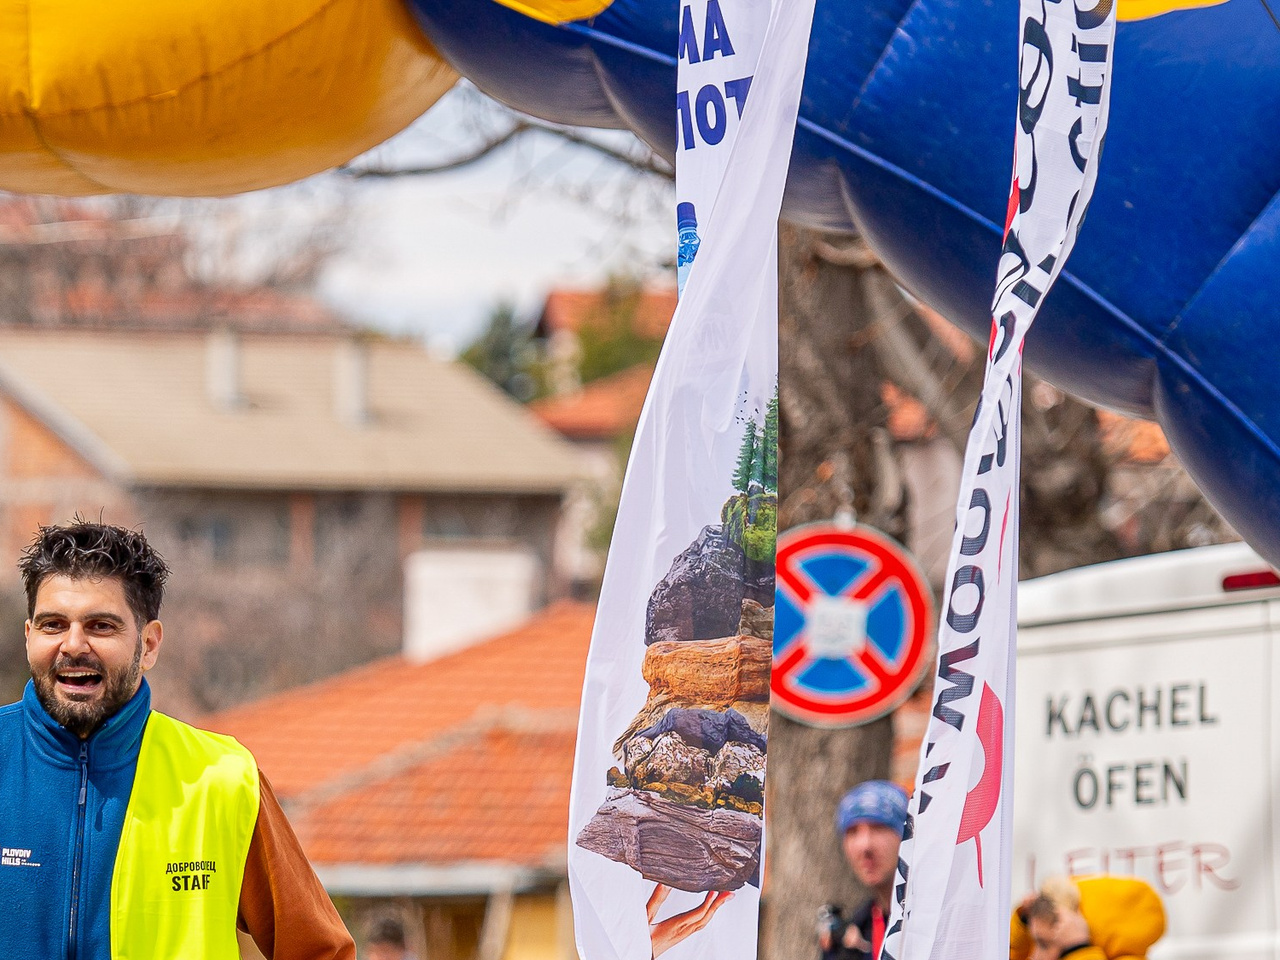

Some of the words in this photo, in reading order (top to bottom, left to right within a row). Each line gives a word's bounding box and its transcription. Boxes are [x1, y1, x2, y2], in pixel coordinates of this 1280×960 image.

[1045, 680, 1219, 738] KACHEL
[1073, 754, 1188, 810] ÖFEN
[2, 848, 31, 858] PLOVDIV
[2, 857, 21, 866] HILLS
[165, 861, 216, 874] ДОБРОВОЕЦ
